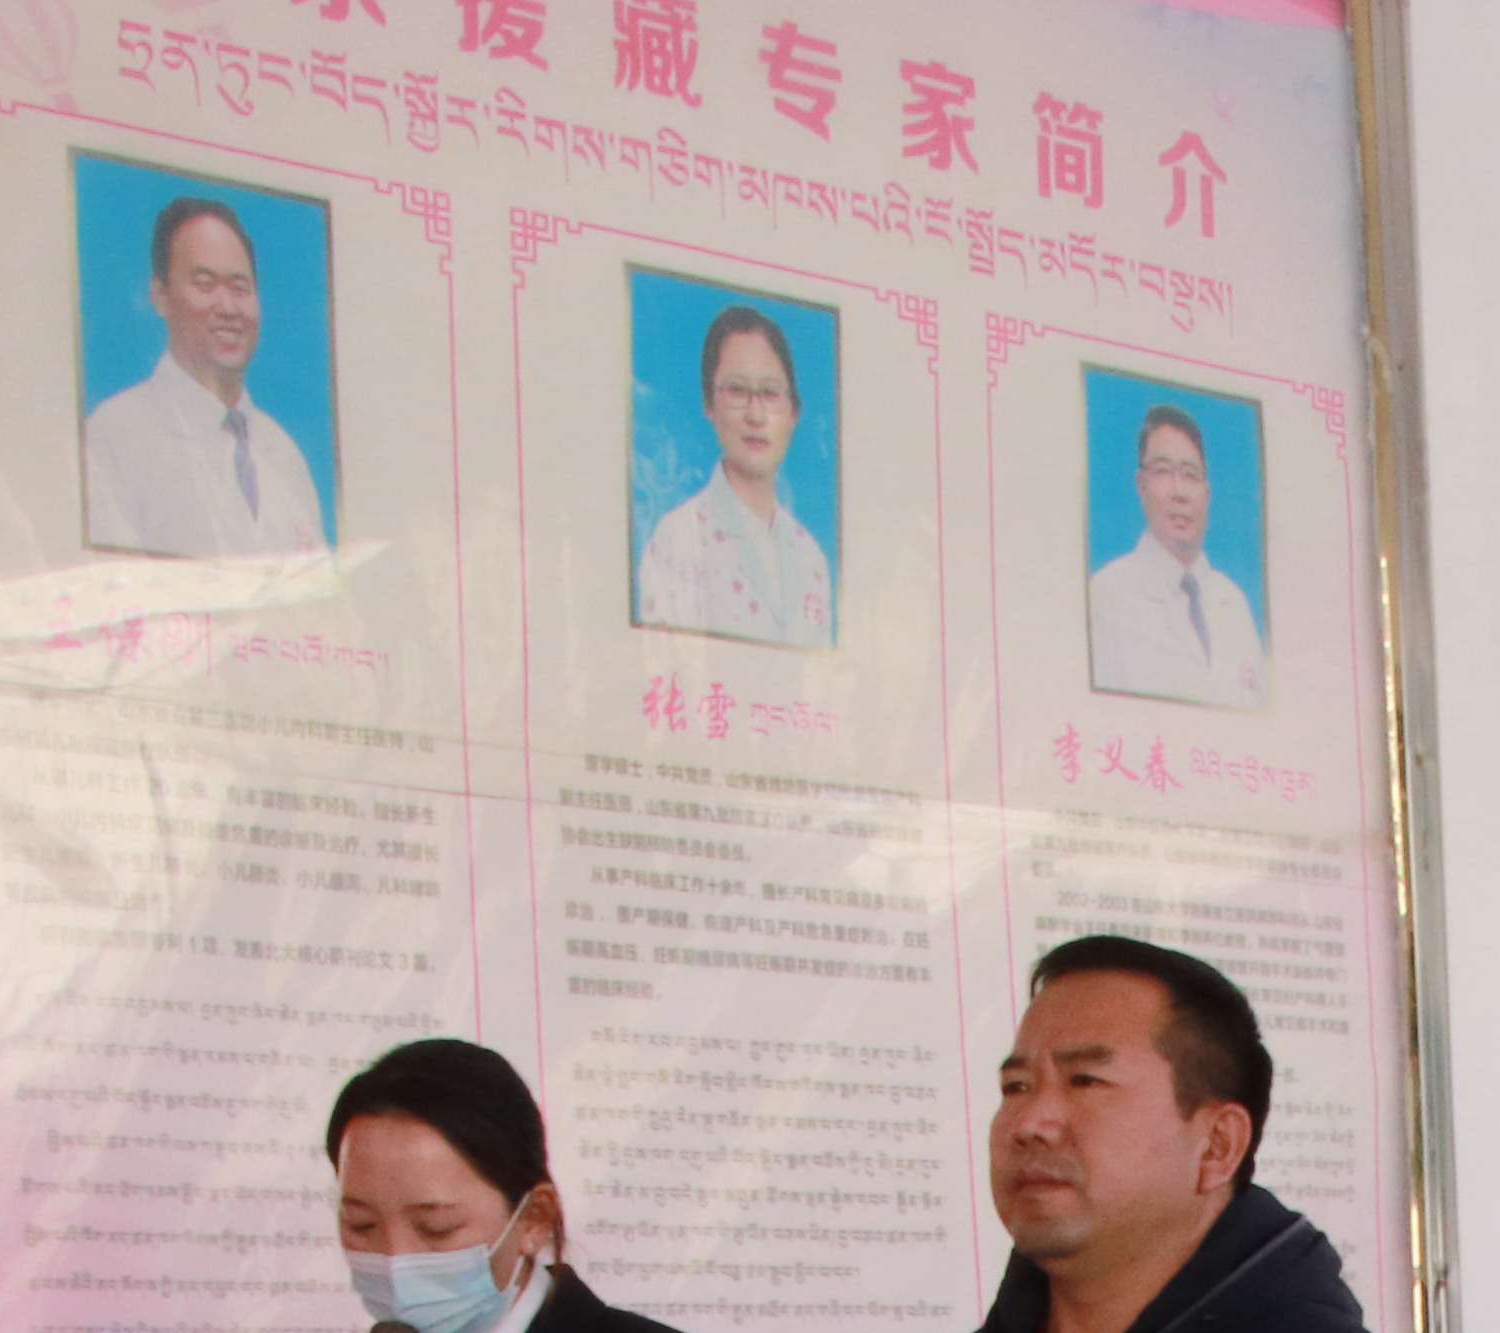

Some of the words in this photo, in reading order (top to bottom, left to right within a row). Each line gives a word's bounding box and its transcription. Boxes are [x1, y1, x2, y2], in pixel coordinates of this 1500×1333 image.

[292, 0, 1228, 238] 援藏专家简介
